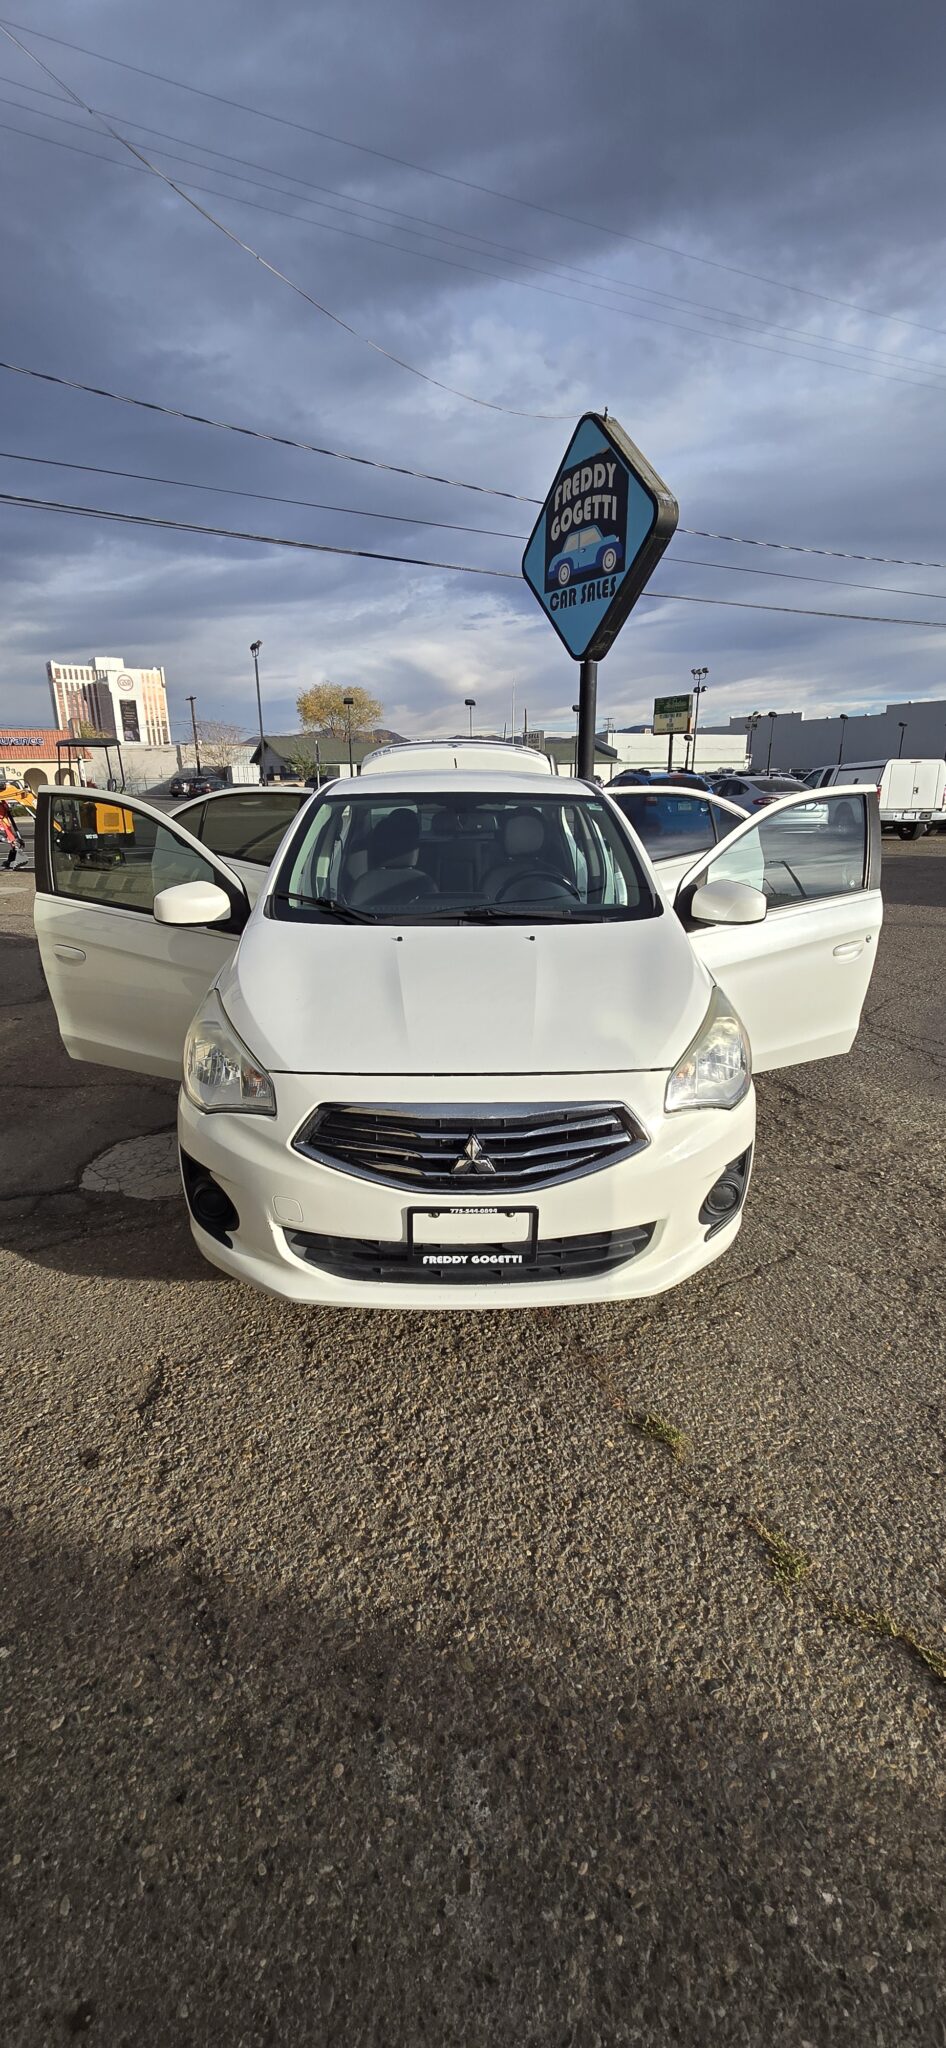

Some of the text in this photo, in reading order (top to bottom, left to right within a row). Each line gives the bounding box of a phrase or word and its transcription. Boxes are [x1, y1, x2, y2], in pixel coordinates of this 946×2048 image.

[555, 462, 617, 512] FREDDY
[550, 494, 617, 541] GOGETTI
[550, 575, 617, 611] CAR SALES
[422, 1255, 523, 1264] FREDDY GOGETTI
